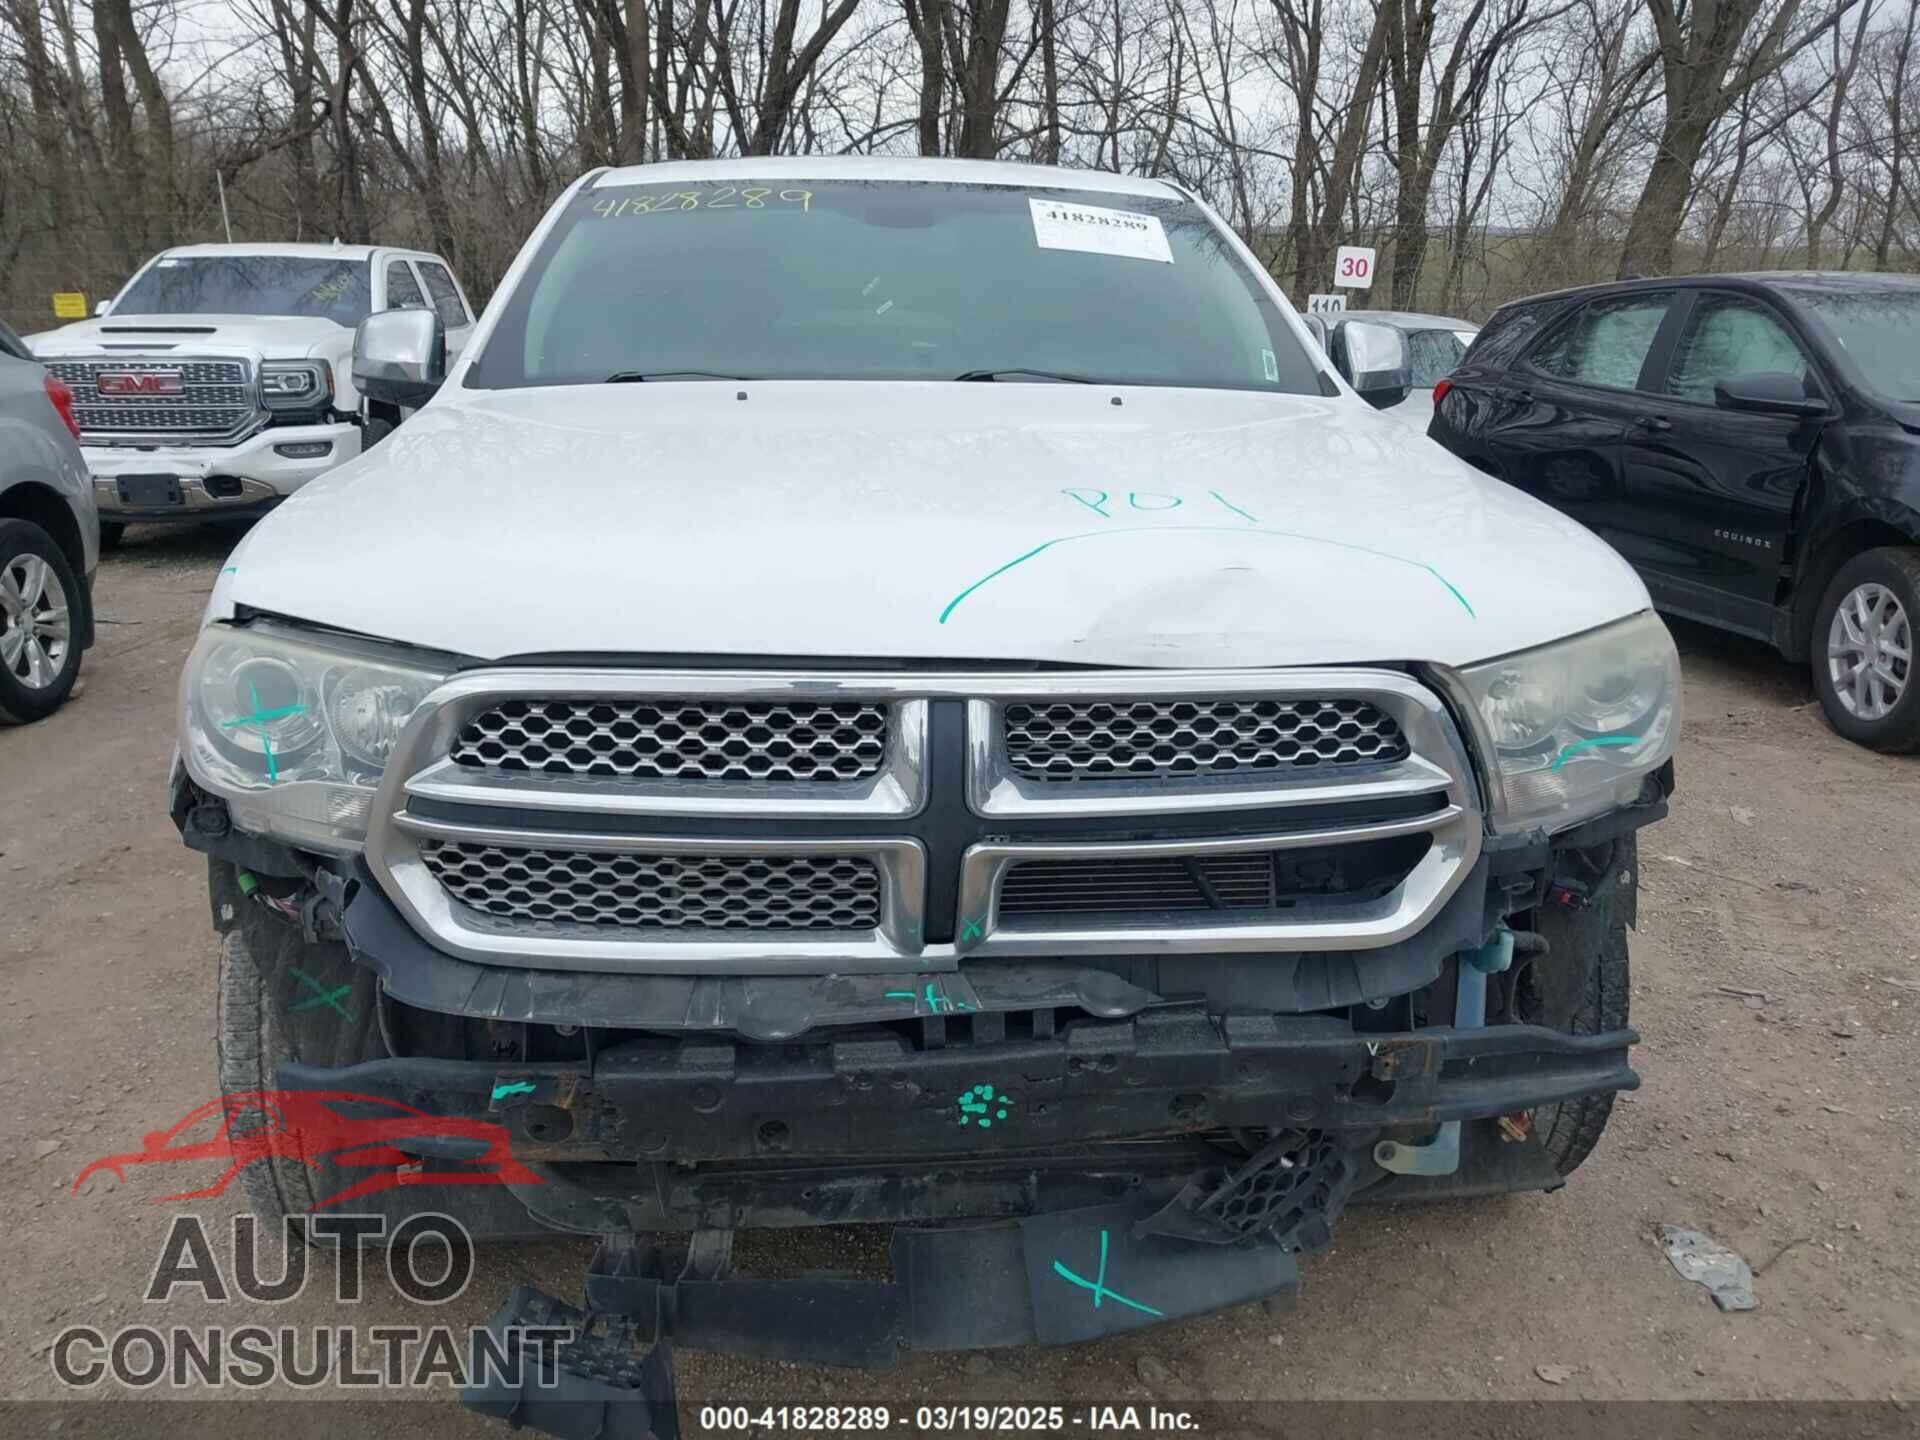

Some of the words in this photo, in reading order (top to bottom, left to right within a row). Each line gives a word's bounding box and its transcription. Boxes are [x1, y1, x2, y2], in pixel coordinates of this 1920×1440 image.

[592, 187, 813, 218] 41828289
[1046, 210, 1149, 231] 41828289
[1341, 257, 1369, 278] 30
[1312, 299, 1341, 313] 110
[98, 373, 183, 394] GMC
[1713, 528, 1772, 549] EQUINOX
